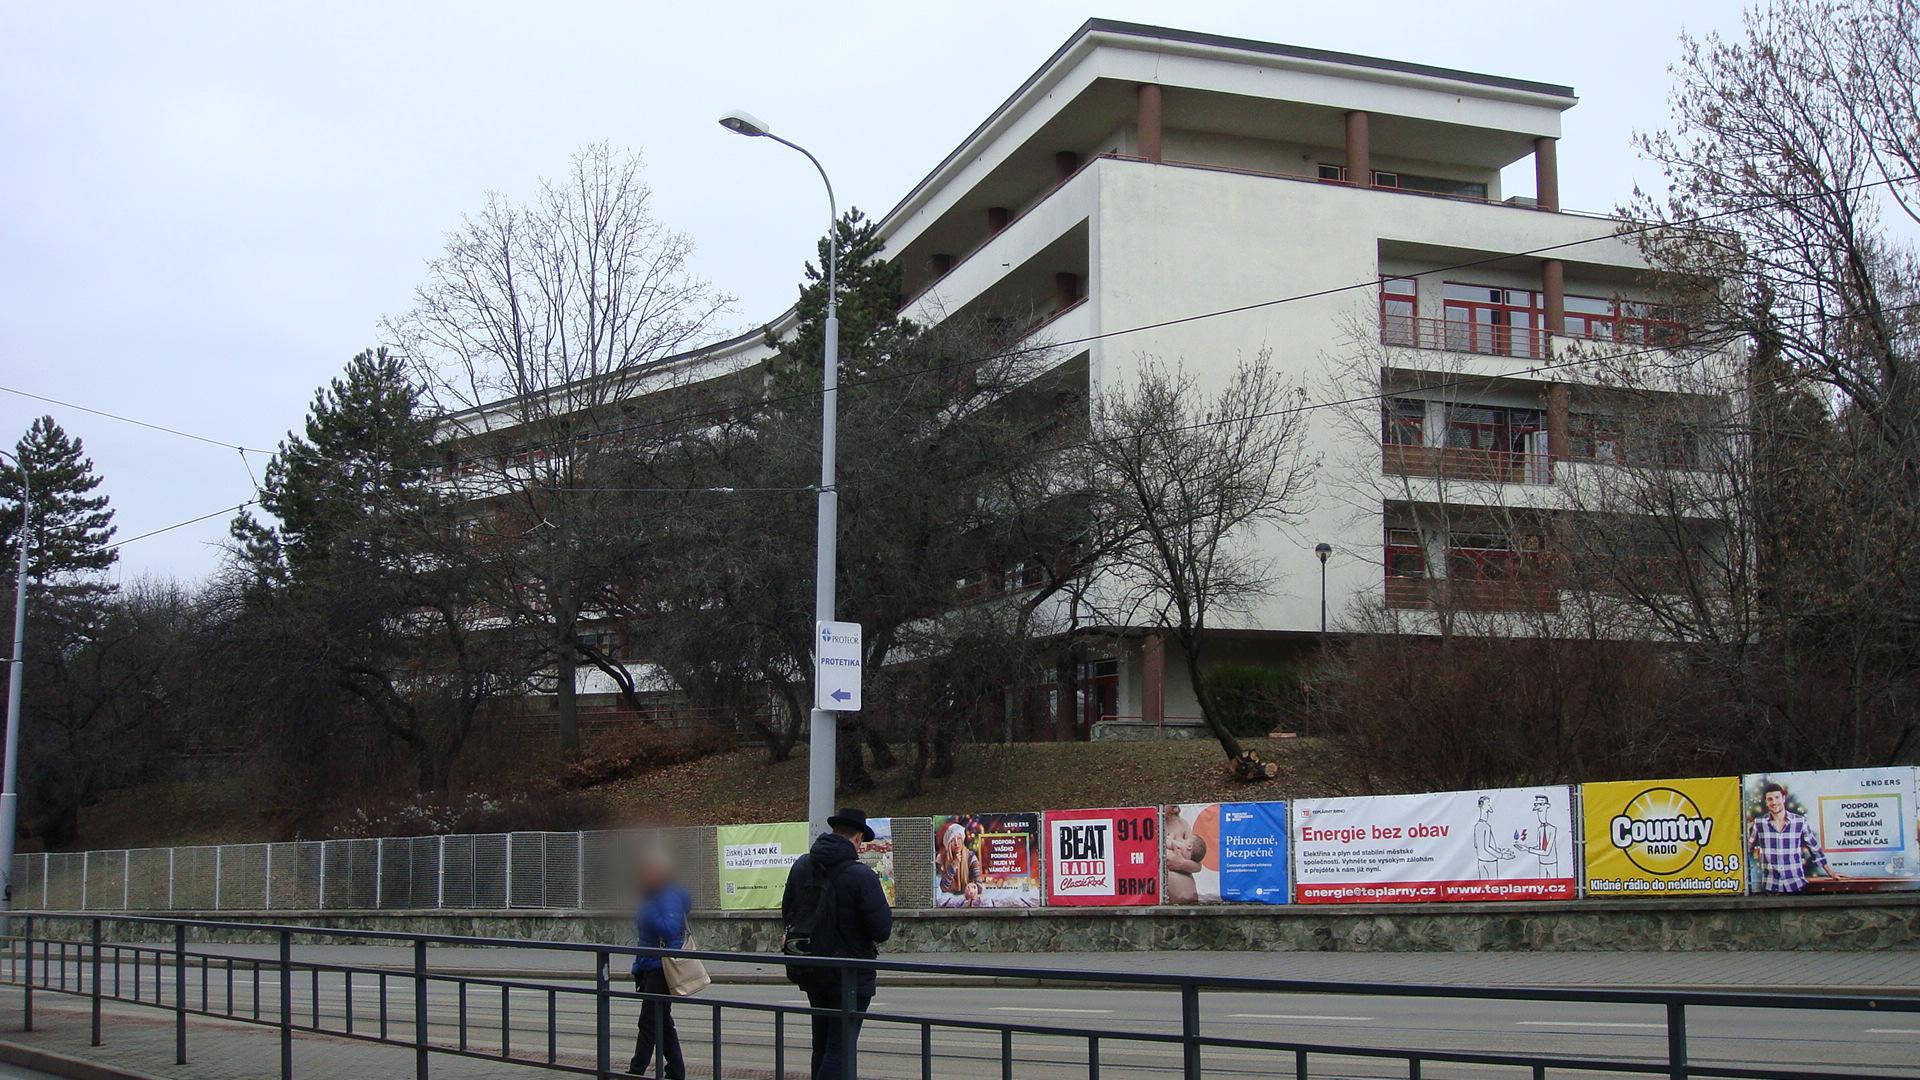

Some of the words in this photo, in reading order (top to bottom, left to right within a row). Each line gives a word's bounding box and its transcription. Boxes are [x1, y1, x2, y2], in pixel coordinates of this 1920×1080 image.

[832, 636, 859, 644] PROTEOR
[821, 657, 860, 666] PROTETIKA
[1860, 779, 1901, 787] LENDERS
[1840, 819, 1882, 828] PODNIKÁNÍ
[1118, 818, 1154, 842] 91,0
[1302, 826, 1366, 843] Energie
[1372, 825, 1402, 839] bez
[1408, 823, 1449, 838] obav
[1611, 815, 1713, 848] Country
[1060, 825, 1107, 860] BEAT
[1226, 835, 1278, 846] Přirozeně,
[1836, 838, 1871, 846] VÁNOČNÍ
[1874, 837, 1888, 845] ČAS
[726, 848, 743, 857] Získej
[769, 846, 778, 854] Kč
[1226, 848, 1274, 859] bezpečně
[1648, 844, 1677, 855] RADIO
[735, 858, 753, 867] každý
[1130, 852, 1144, 864] FM
[1704, 854, 1738, 873] 96,8
[1062, 862, 1104, 874] RADIO
[1119, 878, 1155, 896] BRNO
[1590, 879, 1621, 891] Klidné
[1624, 878, 1649, 890] rádio
[1652, 879, 1664, 890] do
[1668, 878, 1711, 890] neklidné
[1714, 878, 1739, 891] doby
[1304, 886, 1436, 898] energie@teplarny.cz
[1447, 884, 1566, 895] www.teplarny.cz
